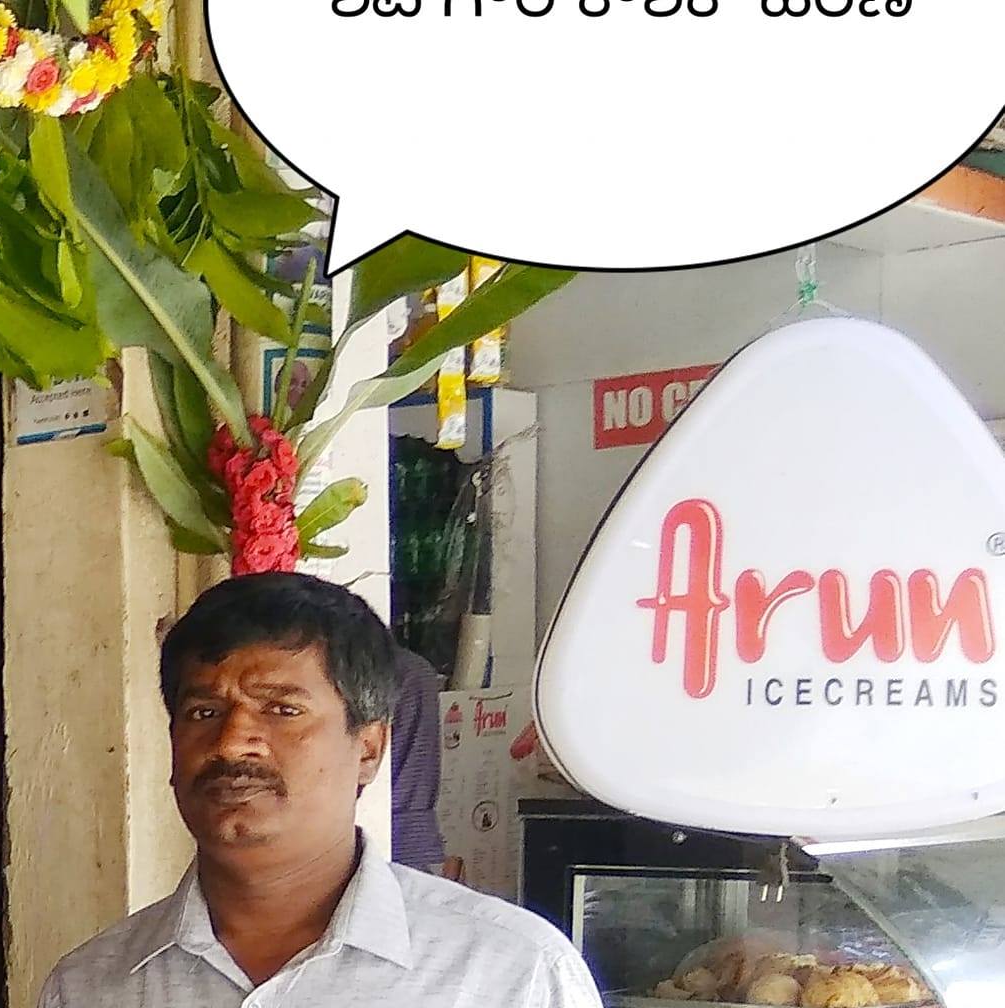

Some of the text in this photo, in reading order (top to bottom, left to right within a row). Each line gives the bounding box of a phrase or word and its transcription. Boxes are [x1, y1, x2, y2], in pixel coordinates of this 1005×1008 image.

[602, 386, 653, 431] NO
[636, 498, 996, 699] Arun
[746, 678, 998, 707] ICECREAMS
